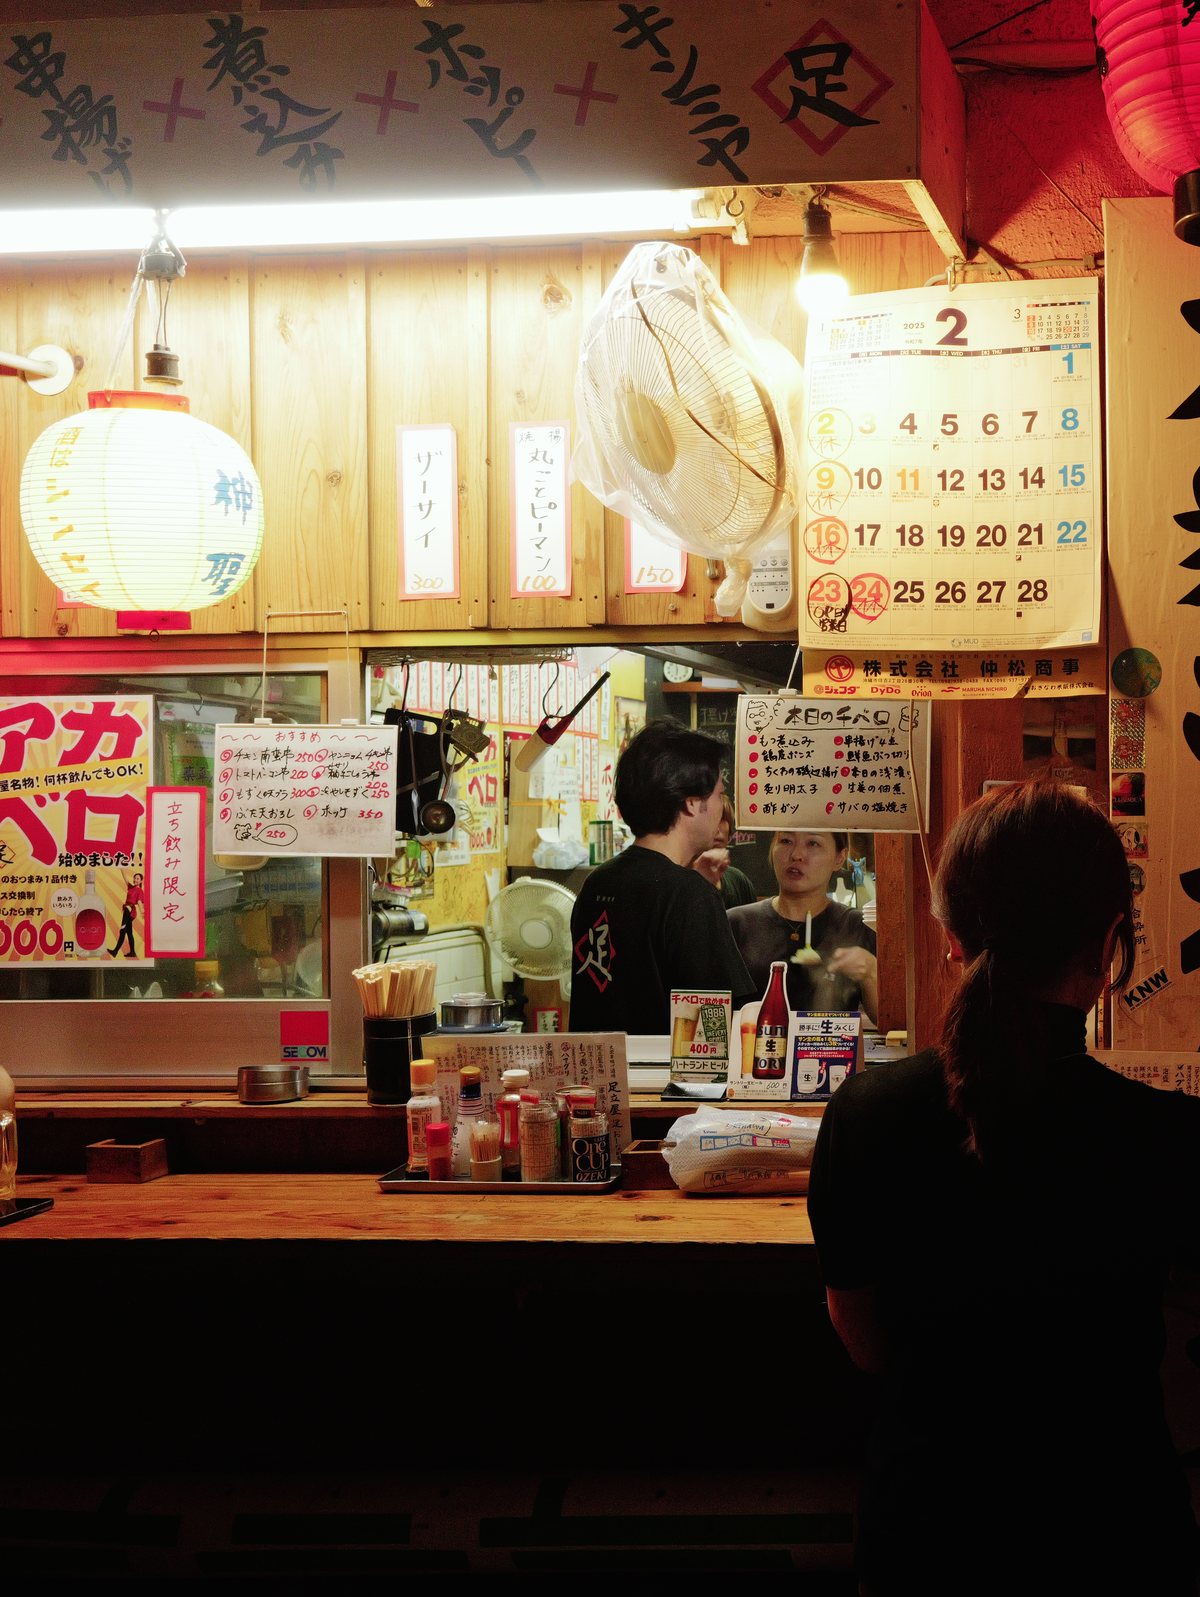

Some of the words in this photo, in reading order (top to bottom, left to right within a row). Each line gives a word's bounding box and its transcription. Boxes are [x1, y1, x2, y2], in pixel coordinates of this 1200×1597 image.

[784, 42, 880, 128] 足
[613, 2, 749, 184] キンミヤ
[205, 14, 343, 193] 煮込み
[403, 18, 546, 188] ホッピー
[3, 30, 138, 200] 串揚げ
[1013, 308, 1021, 320] 3
[903, 322, 925, 330] 2025
[935, 308, 968, 346] 2
[1062, 352, 1074, 374] 1
[818, 413, 836, 435] 2
[859, 413, 877, 435] 3
[899, 413, 918, 435] 4
[941, 413, 959, 436] 5
[981, 413, 1000, 435] 6
[1022, 411, 1039, 433] 7
[1061, 408, 1080, 431] 8
[816, 467, 835, 490] 9
[854, 467, 882, 490] 10
[896, 468, 919, 491] 11
[937, 469, 965, 492] 12
[978, 468, 1006, 491] 13
[1018, 466, 1046, 489] 14
[1058, 464, 1086, 487] 15
[414, 449, 444, 549] ザーサイ
[528, 447, 558, 573] 丸ごとピーマン
[812, 523, 841, 546] 16
[854, 524, 881, 546] 17
[896, 524, 924, 547] 18
[937, 525, 965, 547] 19
[976, 525, 1007, 547] 20
[1017, 523, 1044, 546] 21
[1056, 520, 1088, 544] 22
[410, 575, 445, 591] 300
[522, 574, 557, 591] 100
[635, 566, 674, 586] 150
[810, 580, 841, 602] 23
[852, 580, 883, 602] 24
[893, 581, 925, 603] 25
[935, 581, 966, 603] 26
[976, 580, 1007, 603] 27
[1017, 579, 1048, 602] 28
[863, 659, 959, 678] 株式会社
[980, 658, 1080, 677] 仲松商事
[871, 687, 901, 695] DyDo
[911, 689, 932, 698] Orion
[784, 705, 890, 727] 本日の千ベロ
[275, 731, 321, 743] おすすめ
[759, 736, 815, 749] もつ煮込み
[844, 735, 899, 749] 串揚げ4点
[295, 752, 314, 762] 250
[761, 749, 815, 763] 鶏皮ポンズ
[367, 761, 389, 771] 250
[44, 763, 144, 787] 何杯飲んでもOK!
[290, 769, 308, 779] 200
[365, 781, 388, 789] 200
[763, 783, 818, 796] 炙り明太子
[290, 787, 308, 799] 300
[370, 789, 390, 799] 250
[236, 806, 295, 819] ぶた天おろし
[321, 804, 348, 818] ホッケ
[357, 809, 383, 819] 350
[837, 801, 908, 815] サバの塩焼き
[266, 830, 286, 839] 250
[58, 851, 143, 869] 始めました!!
[162, 801, 187, 922] 立ち飲み限定
[1, 874, 78, 884] のおつまみ1品付き
[0, 891, 36, 900] ス交換制
[64, 940, 74, 952] 円
[1122, 967, 1169, 1009] KNW
[704, 1007, 725, 1019] 1986
[758, 1025, 783, 1036] sun
[820, 1019, 833, 1034] 生
[283, 1046, 327, 1058] SECOM
[689, 1043, 709, 1054] 400
[765, 1039, 777, 1052] 生
[561, 1052, 570, 1077] ハマグリ
[672, 1060, 709, 1070] ハートランド
[710, 1061, 729, 1070] ビール
[766, 1082, 780, 1090] 600
[1175, 1070, 1185, 1090] ハブ
[607, 1081, 622, 1116] 足立屋
[572, 1138, 607, 1156] One
[576, 1152, 609, 1172] CUP
[576, 1170, 607, 1182] OZEKI
